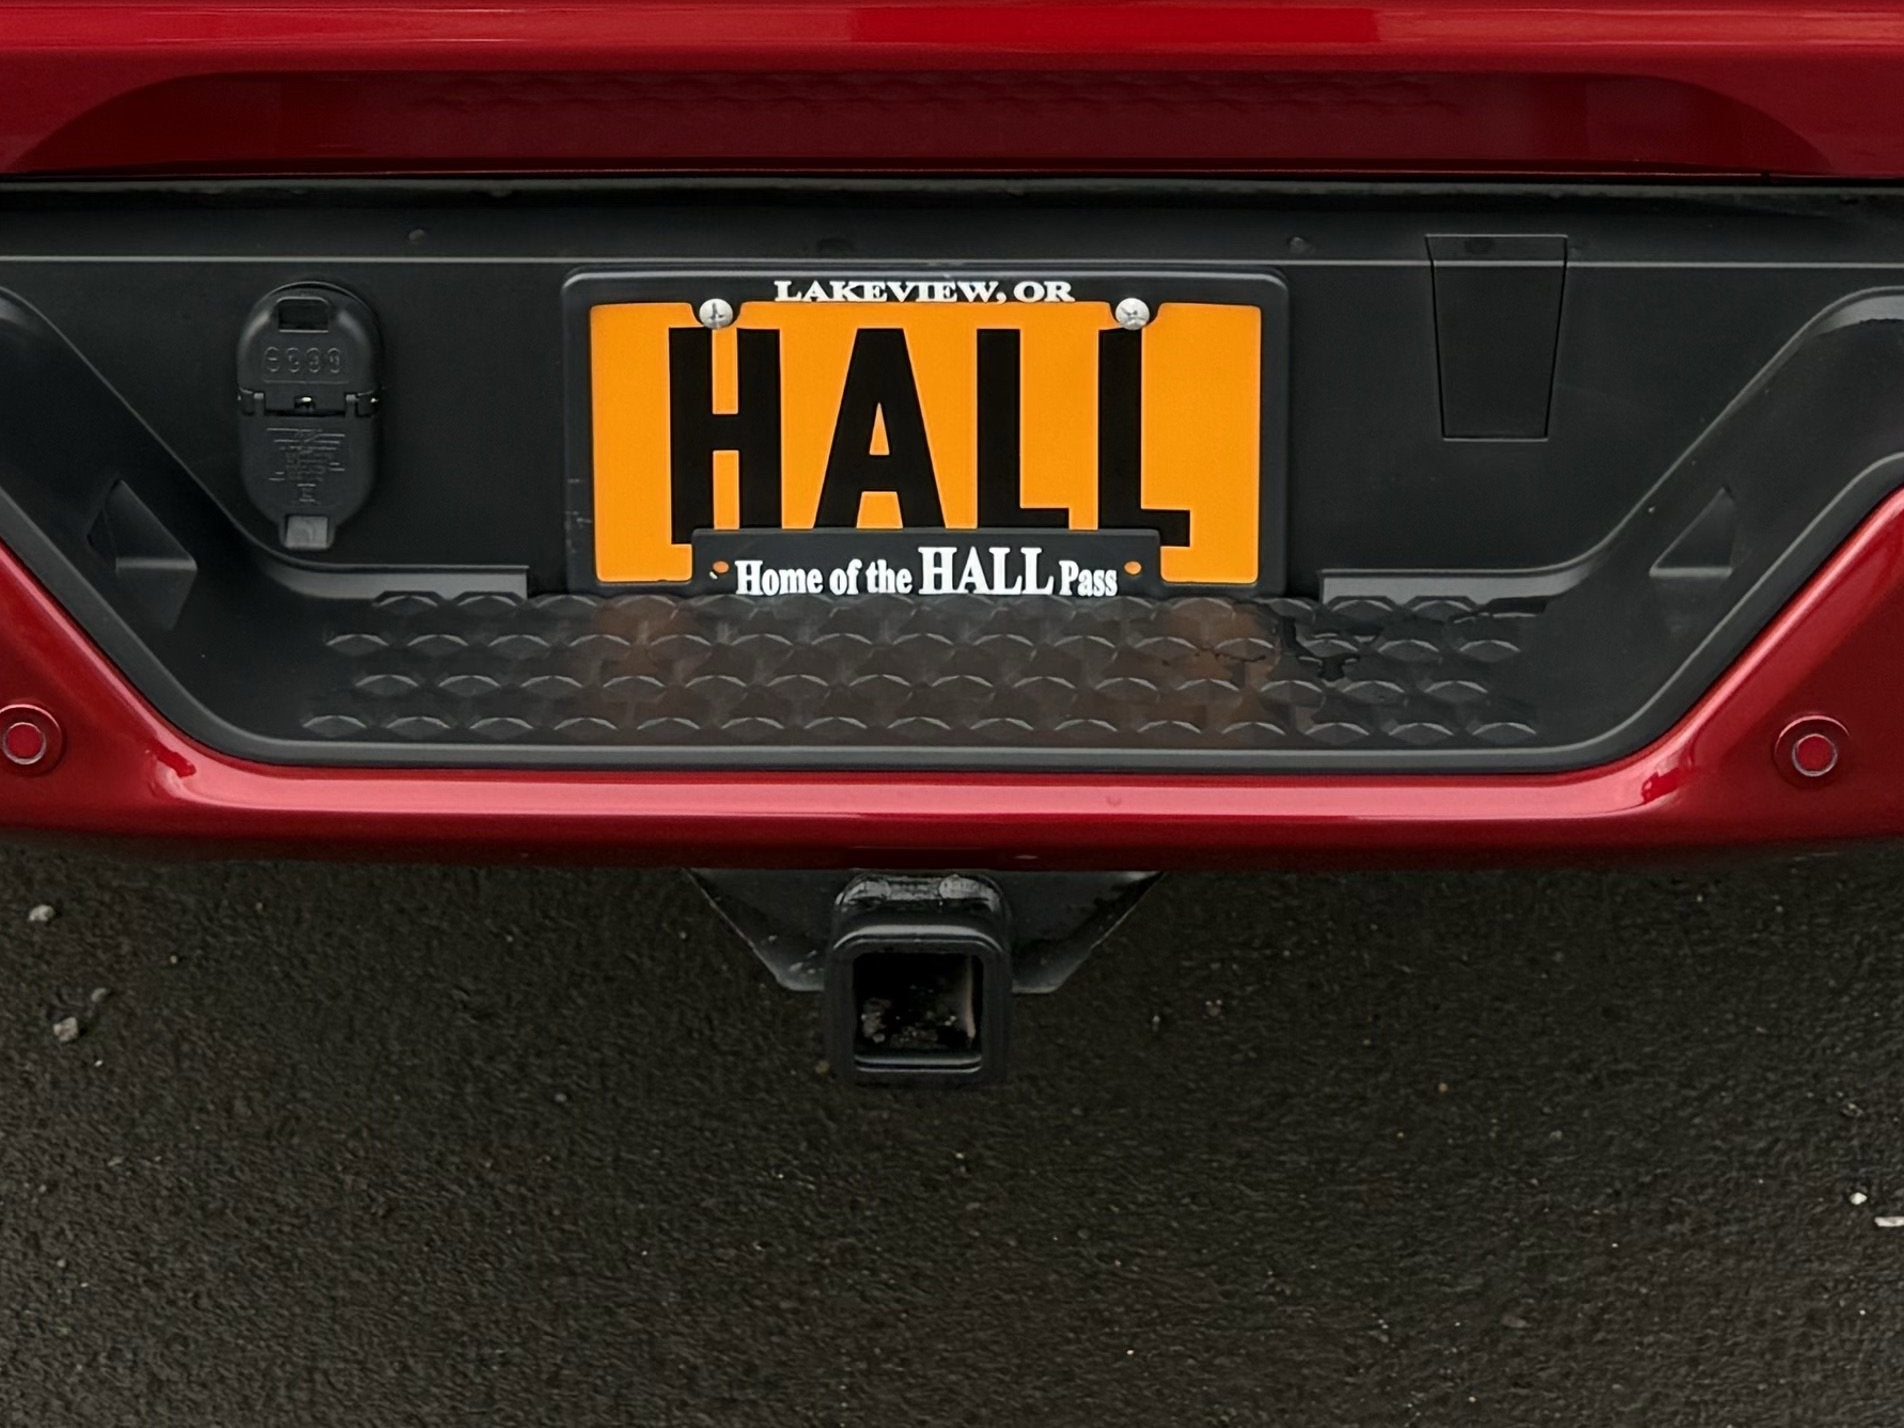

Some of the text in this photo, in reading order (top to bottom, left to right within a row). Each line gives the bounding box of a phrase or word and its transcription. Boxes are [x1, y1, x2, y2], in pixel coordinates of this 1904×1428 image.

[774, 279, 1076, 304] LAKEVIEW, OR
[669, 327, 1191, 547] HALL
[734, 545, 1118, 597] Home of the HALL Pass
